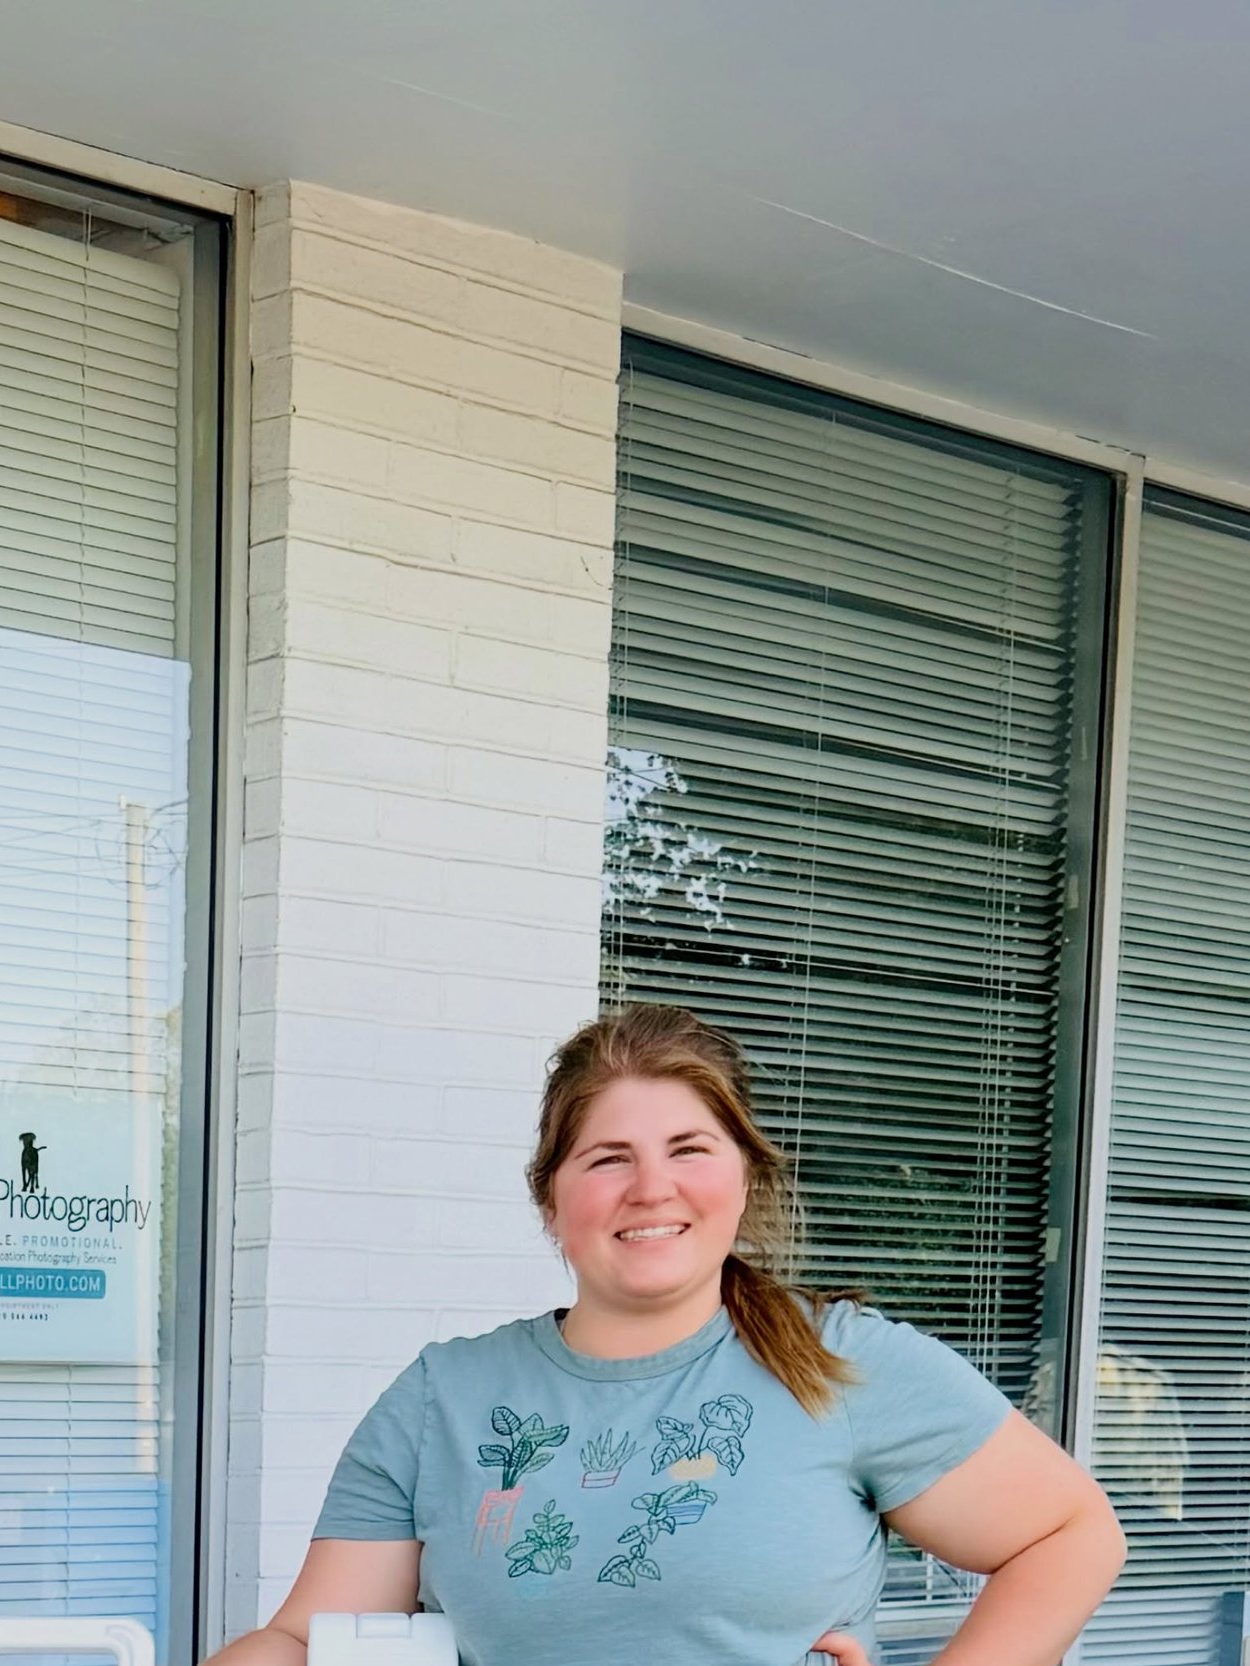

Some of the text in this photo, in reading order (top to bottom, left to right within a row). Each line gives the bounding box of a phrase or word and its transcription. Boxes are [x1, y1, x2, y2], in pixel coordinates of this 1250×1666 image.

[22, 1235, 123, 1250] PROMOTIONAL.
[28, 1250, 81, 1266] Photography
[83, 1252, 117, 1264] Services
